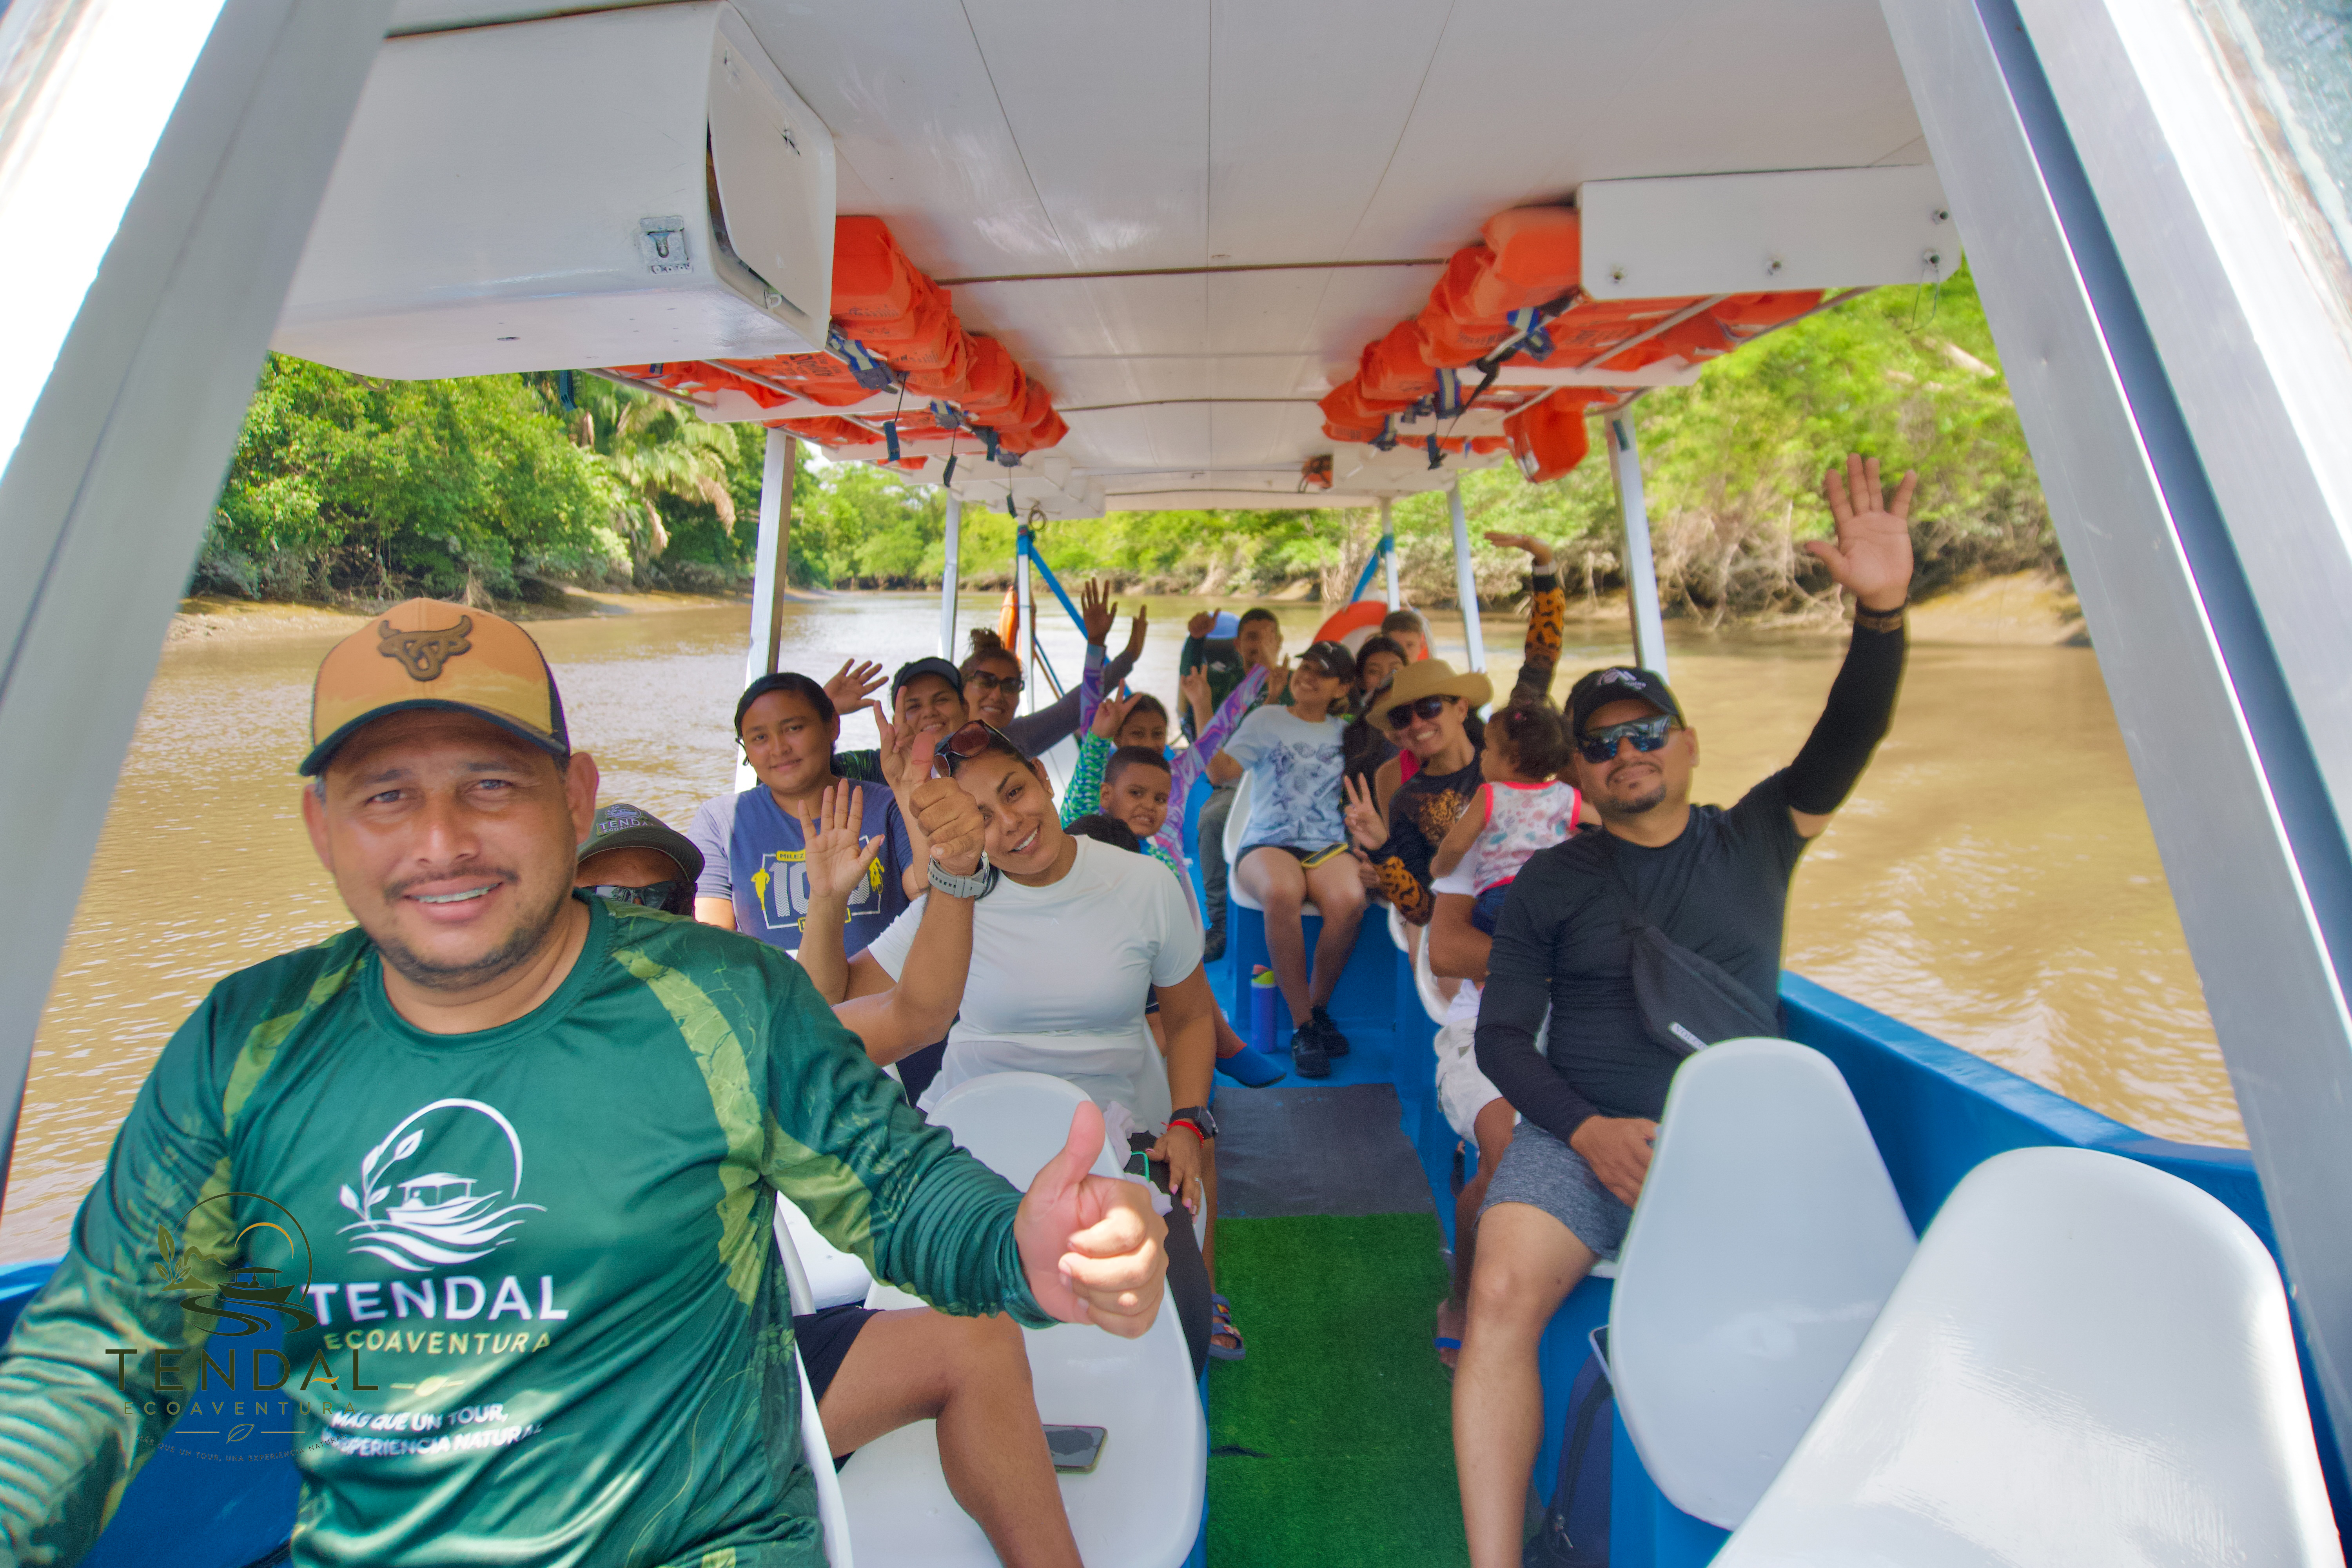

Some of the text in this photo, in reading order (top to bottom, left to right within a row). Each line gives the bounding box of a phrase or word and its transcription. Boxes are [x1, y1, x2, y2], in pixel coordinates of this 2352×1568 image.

[599, 818, 653, 829] TENDA
[301, 1275, 569, 1326] TENDAL
[323, 1328, 550, 1354] ECOAVENTURA
[370, 1412, 411, 1431] QUE
[410, 1412, 443, 1432] UN
[448, 1403, 508, 1425] TOUR,
